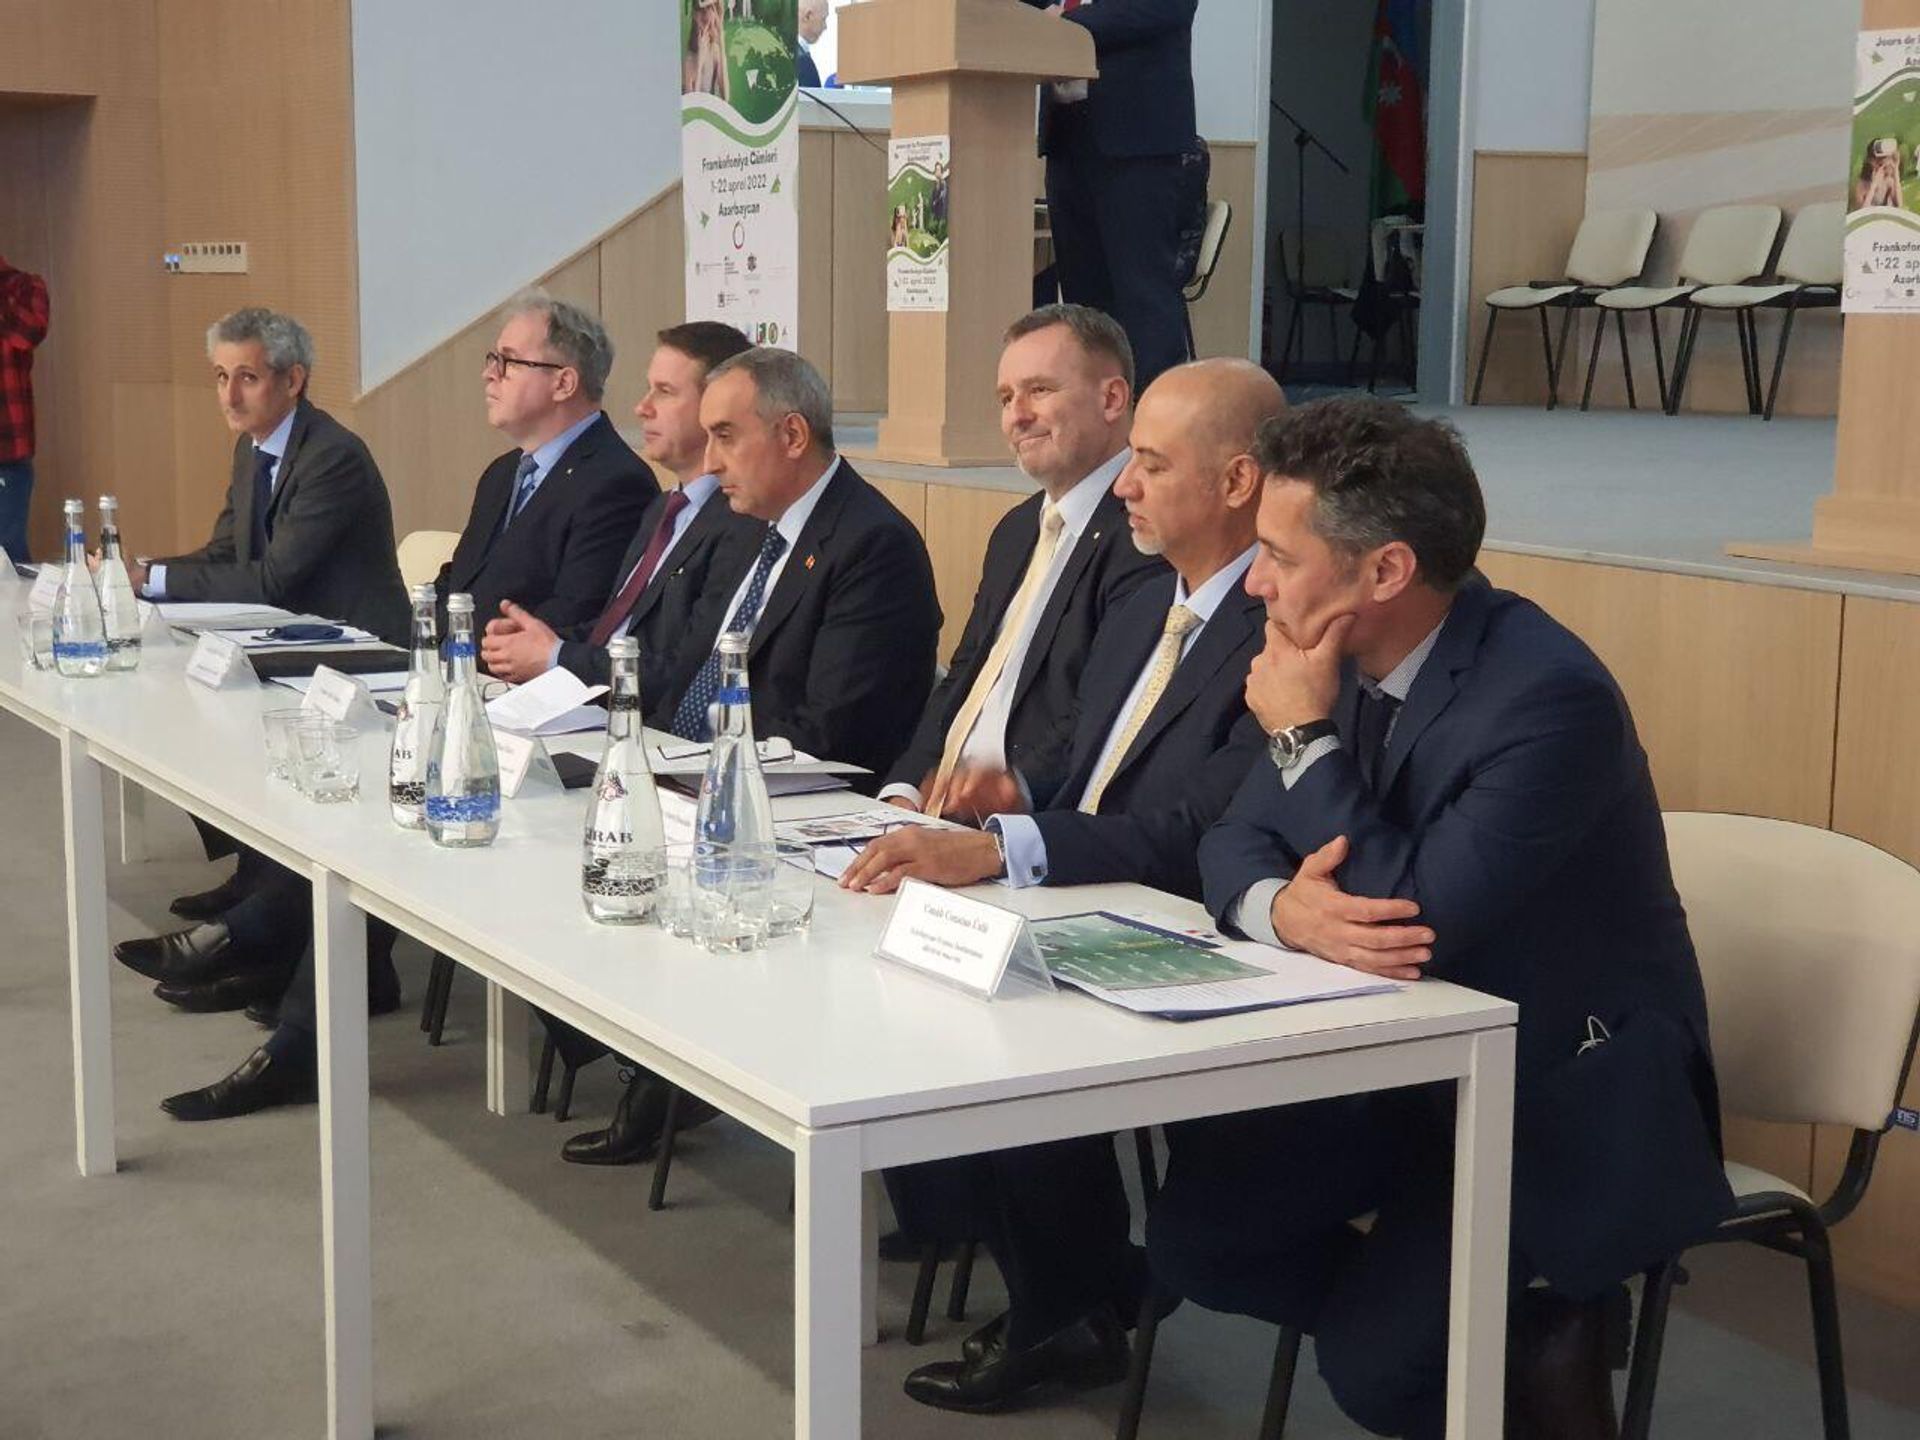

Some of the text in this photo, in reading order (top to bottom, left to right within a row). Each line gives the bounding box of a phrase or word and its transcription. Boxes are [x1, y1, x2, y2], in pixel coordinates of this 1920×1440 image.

[711, 178, 727, 193] 1-22
[747, 173, 767, 190] 2022
[1875, 256, 1899, 269] 1-22
